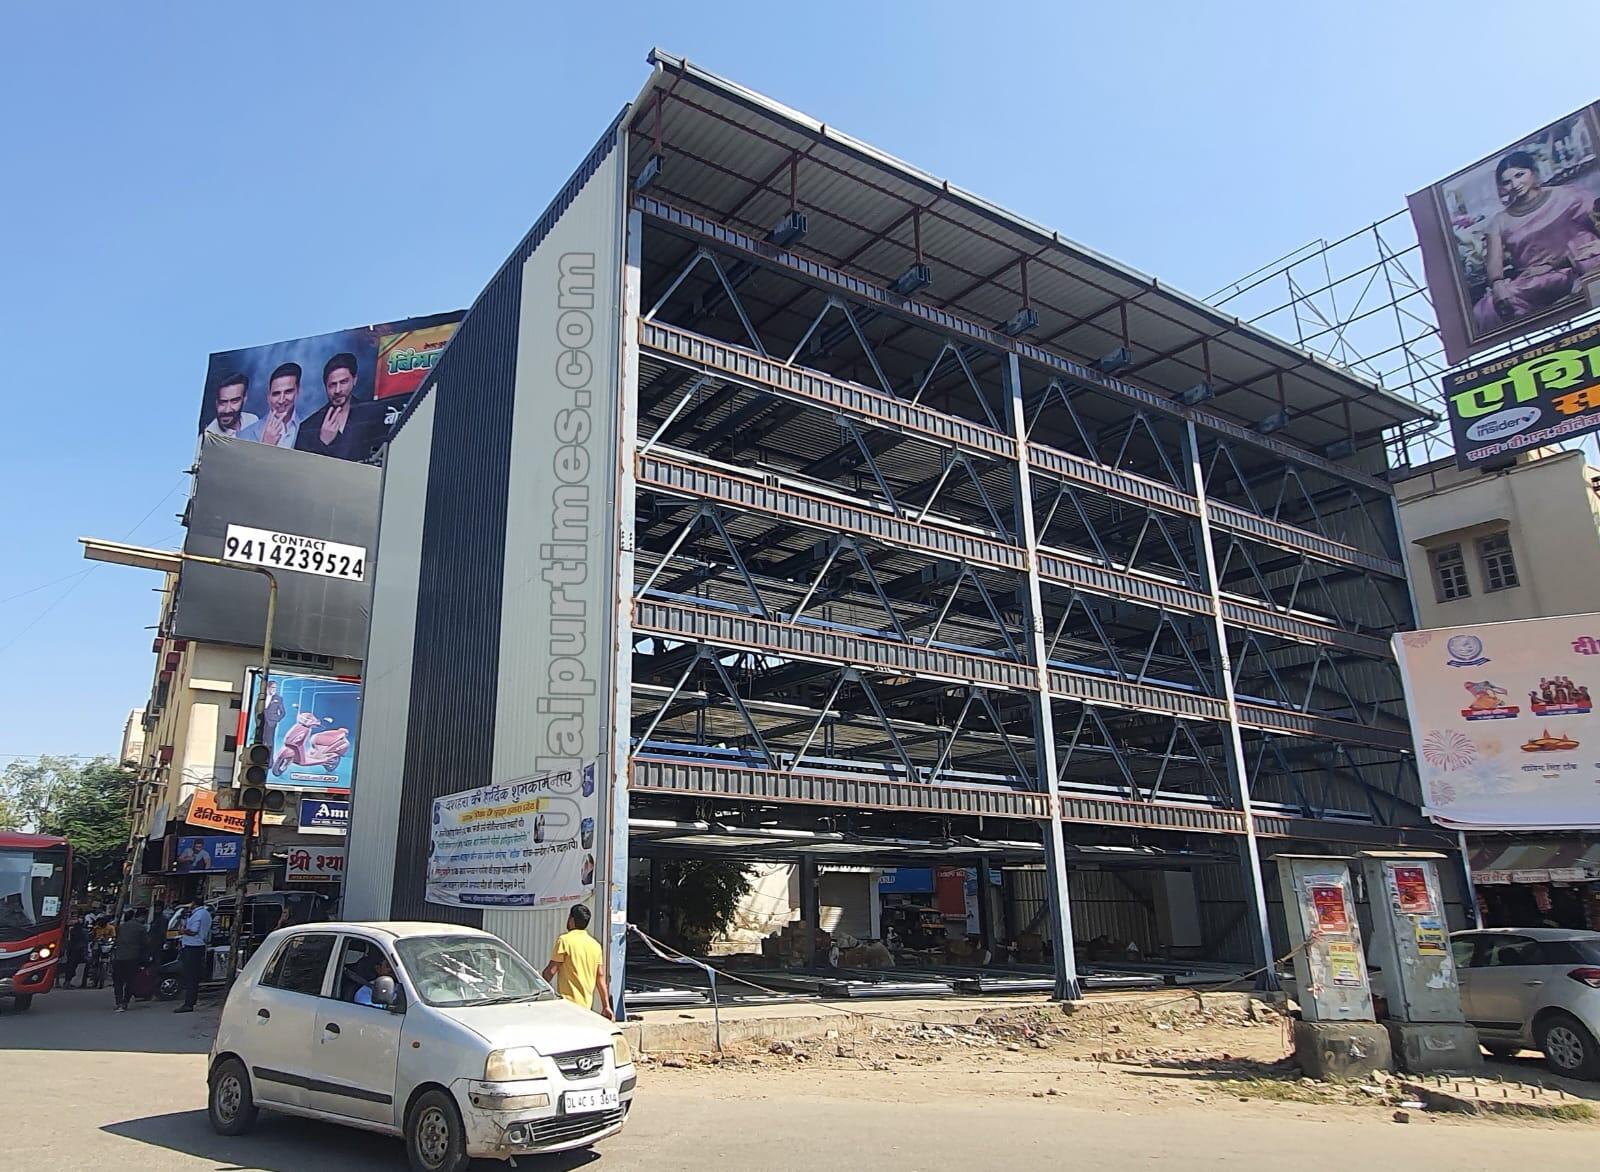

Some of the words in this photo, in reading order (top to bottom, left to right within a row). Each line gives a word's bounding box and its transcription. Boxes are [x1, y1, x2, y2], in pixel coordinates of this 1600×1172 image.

[1454, 372, 1478, 385] 20
[1477, 417, 1521, 437] insider
[271, 532, 327, 552] CONTACT
[226, 536, 364, 579] 9414239524
[193, 806, 223, 823] दैनिक
[289, 849, 312, 872] श्री
[566, 1096, 576, 1109] DL
